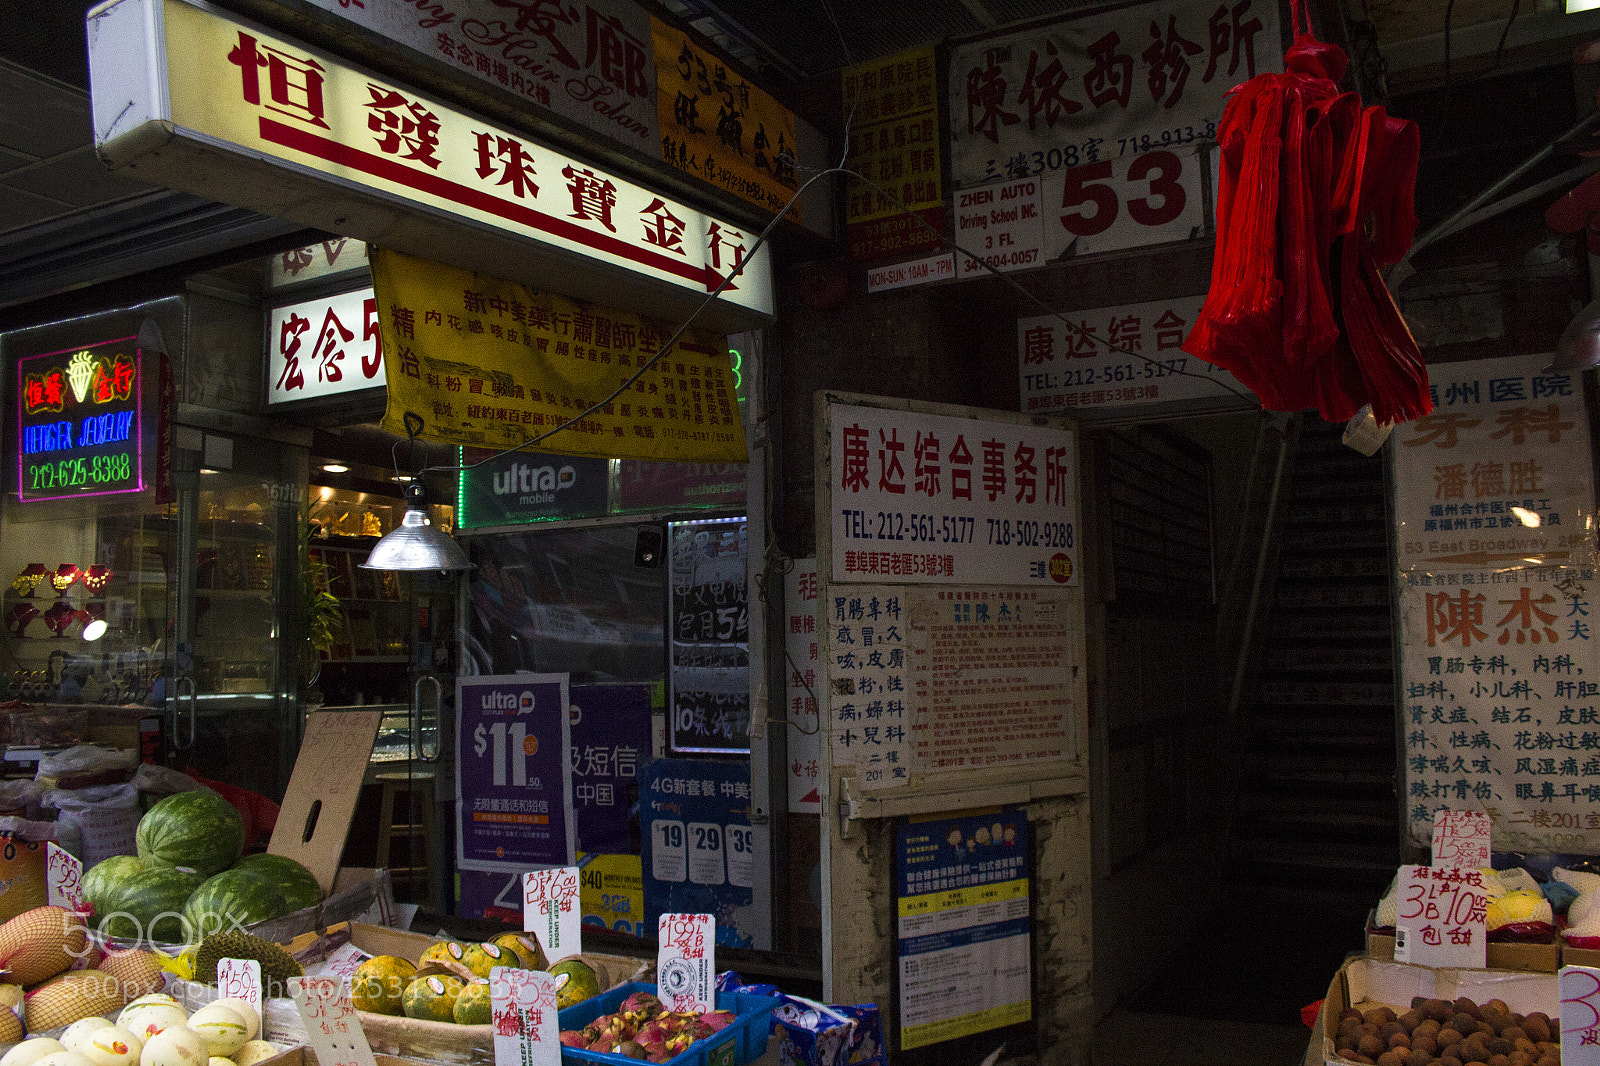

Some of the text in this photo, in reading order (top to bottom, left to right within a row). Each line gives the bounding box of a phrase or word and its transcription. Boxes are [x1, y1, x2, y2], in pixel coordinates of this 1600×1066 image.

[461, 18, 561, 84] Hair
[966, 0, 1264, 144] 陳依西診所
[228, 30, 748, 277] 恒發珠寶金行
[1117, 119, 1222, 156] 718-913-8
[959, 182, 1035, 208] ZHEN AUTO
[1059, 150, 1187, 237] 53
[959, 212, 988, 230] Driving
[990, 208, 1018, 226] School
[985, 232, 1015, 249] 3 FL
[868, 258, 952, 287] MON-SUN: 10AM 7PM
[391, 303, 420, 380] 精治
[1024, 374, 1058, 391] TEL:
[1064, 357, 1188, 388] 212-561-5177
[1402, 403, 1576, 448] 牙科
[30, 452, 131, 490] 212-625-8388
[493, 462, 556, 496] ultra
[841, 422, 1068, 507] 康达综合事务所
[519, 491, 555, 505] mobile
[842, 509, 1074, 549] TEL: 212-561-5177 718-502-9288
[1405, 541, 1423, 554] 53
[1428, 540, 1466, 553] East
[1469, 537, 1548, 552] Broadway
[1424, 587, 1560, 648] 陳杰
[481, 690, 517, 710] ultra
[866, 770, 883, 782] 201
[576, 783, 615, 806] 中国
[581, 870, 603, 889] $40
[1400, 884, 1427, 919] 3
